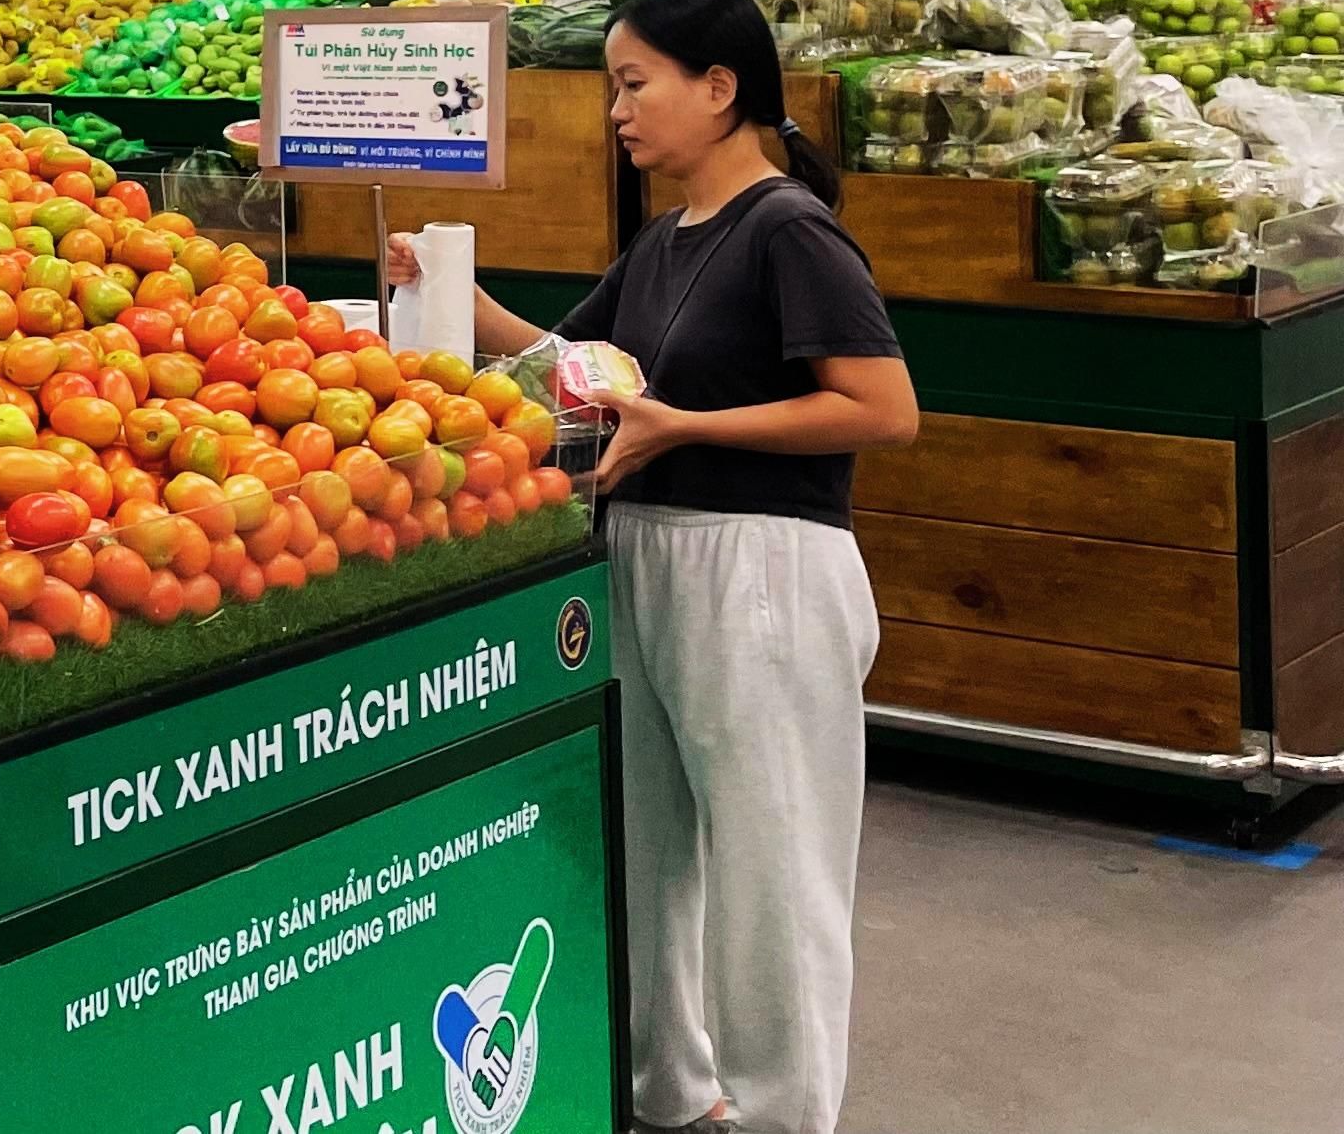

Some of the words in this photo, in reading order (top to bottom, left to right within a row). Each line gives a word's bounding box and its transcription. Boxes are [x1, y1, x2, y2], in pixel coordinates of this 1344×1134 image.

[367, 42, 397, 61] Hủy
[404, 43, 438, 57] Sinh
[444, 43, 475, 61] Học
[68, 767, 162, 846] TICK
[175, 720, 284, 811] XANH
[294, 679, 410, 766] TRÁCH
[420, 637, 516, 719] NHIỆM
[65, 988, 110, 1032] KHU
[115, 964, 160, 1016] VỰC
[165, 937, 231, 992] TRƯNG
[237, 915, 274, 962] BÀY
[278, 897, 316, 941] SẢN
[320, 867, 373, 926] PHẨM
[377, 855, 413, 903] CỦA
[418, 829, 478, 879] DOANH
[481, 802, 540, 851] NGHIỆP
[204, 976, 259, 1019] THAM
[264, 956, 299, 993] GIA
[303, 920, 384, 976] CHƯƠNG
[387, 891, 437, 938] TRÌNH
[260, 1023, 405, 1134] XANH
